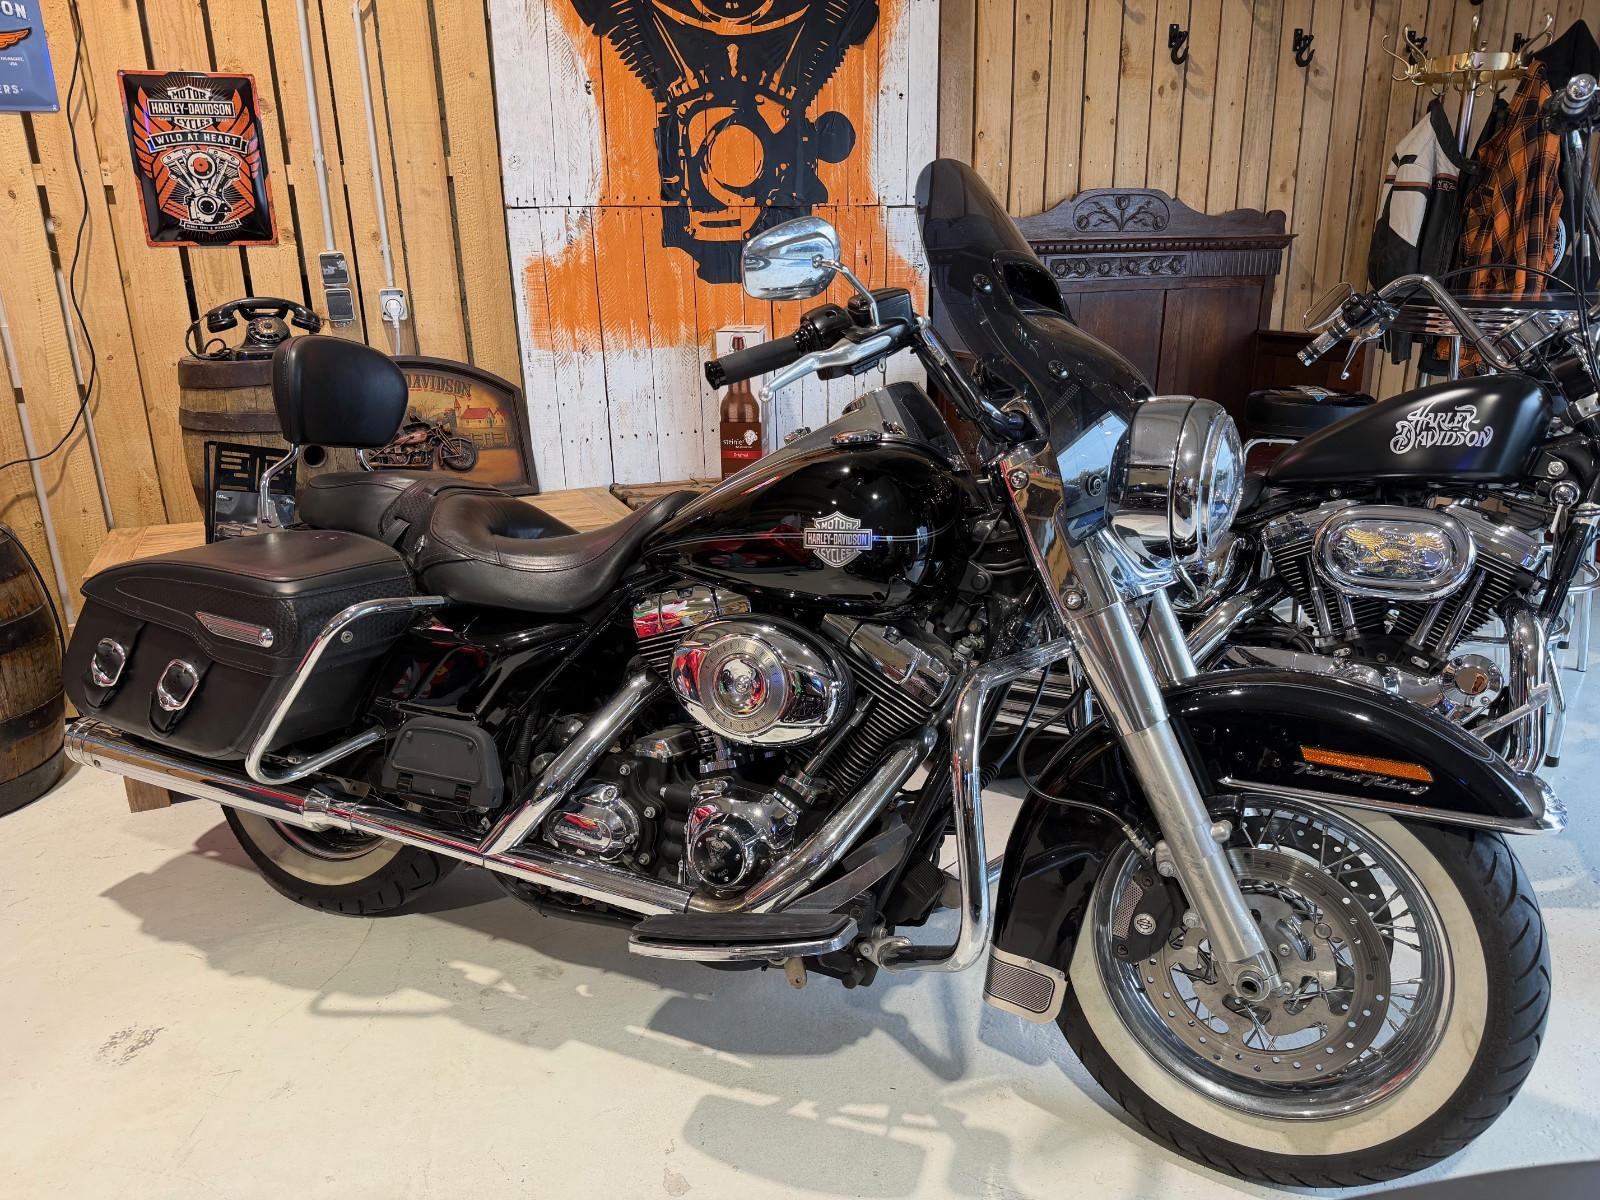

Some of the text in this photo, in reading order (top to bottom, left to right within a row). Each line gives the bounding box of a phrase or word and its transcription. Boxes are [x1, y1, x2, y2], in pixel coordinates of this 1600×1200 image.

[171, 88, 207, 100] MOTOR
[151, 102, 232, 116] HARLEY-DAVIDSON
[177, 119, 211, 131] CYCLES
[155, 132, 238, 146] WILD AT HEART
[1389, 420, 1494, 454] DAVIDSON
[820, 516, 853, 530] MOTOR
[807, 533, 867, 546] HARLEY-DAVIDSON
[820, 548, 852, 563] CYCLES
